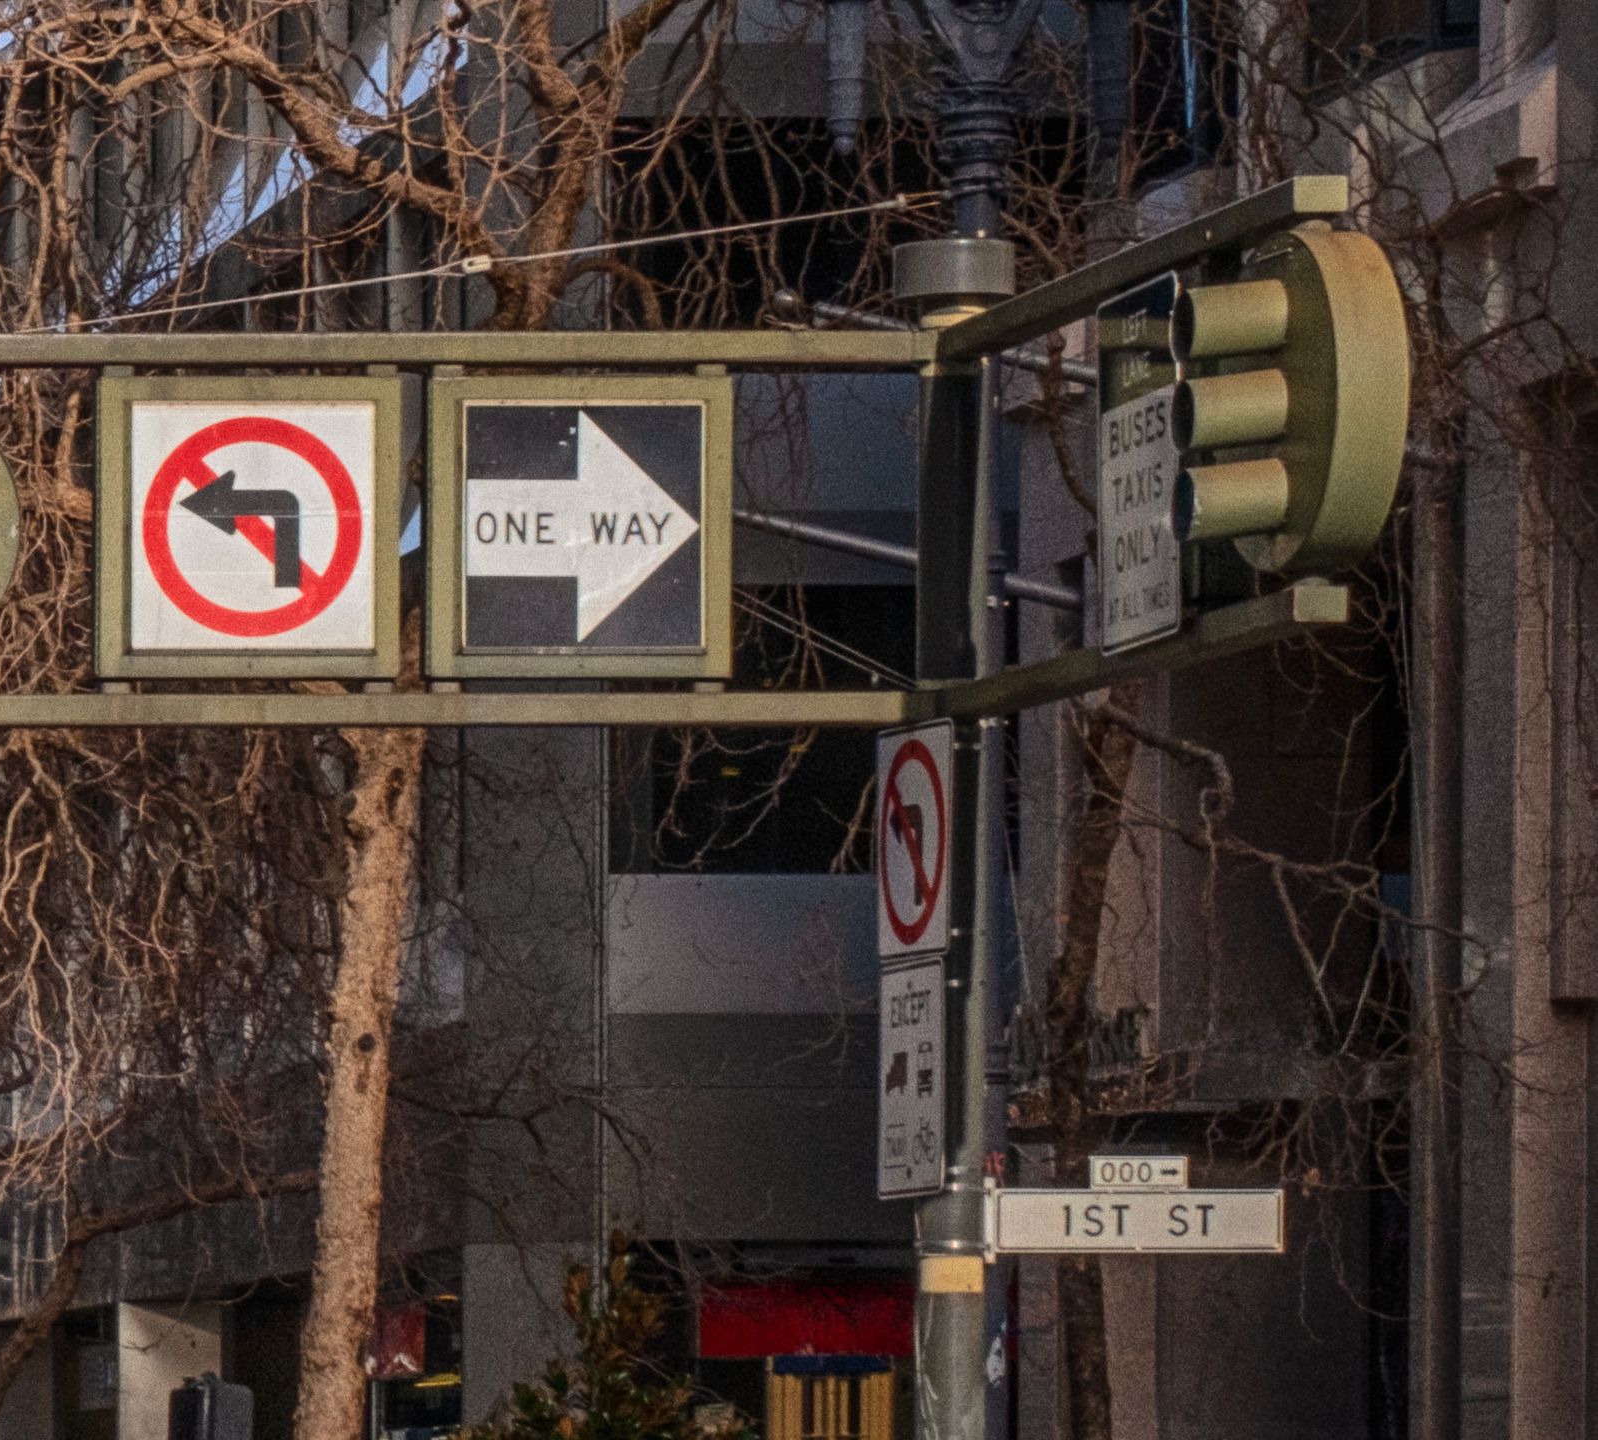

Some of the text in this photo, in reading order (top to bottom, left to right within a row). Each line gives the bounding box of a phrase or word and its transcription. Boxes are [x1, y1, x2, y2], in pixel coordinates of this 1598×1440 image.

[1109, 401, 1166, 457] BUSES
[1112, 463, 1162, 514] TAXIS
[476, 512, 672, 545] ONE WAY
[1115, 524, 1162, 573] ONLY
[1101, 1162, 1152, 1182] 000
[1062, 1204, 1214, 1237] 1ST ST
